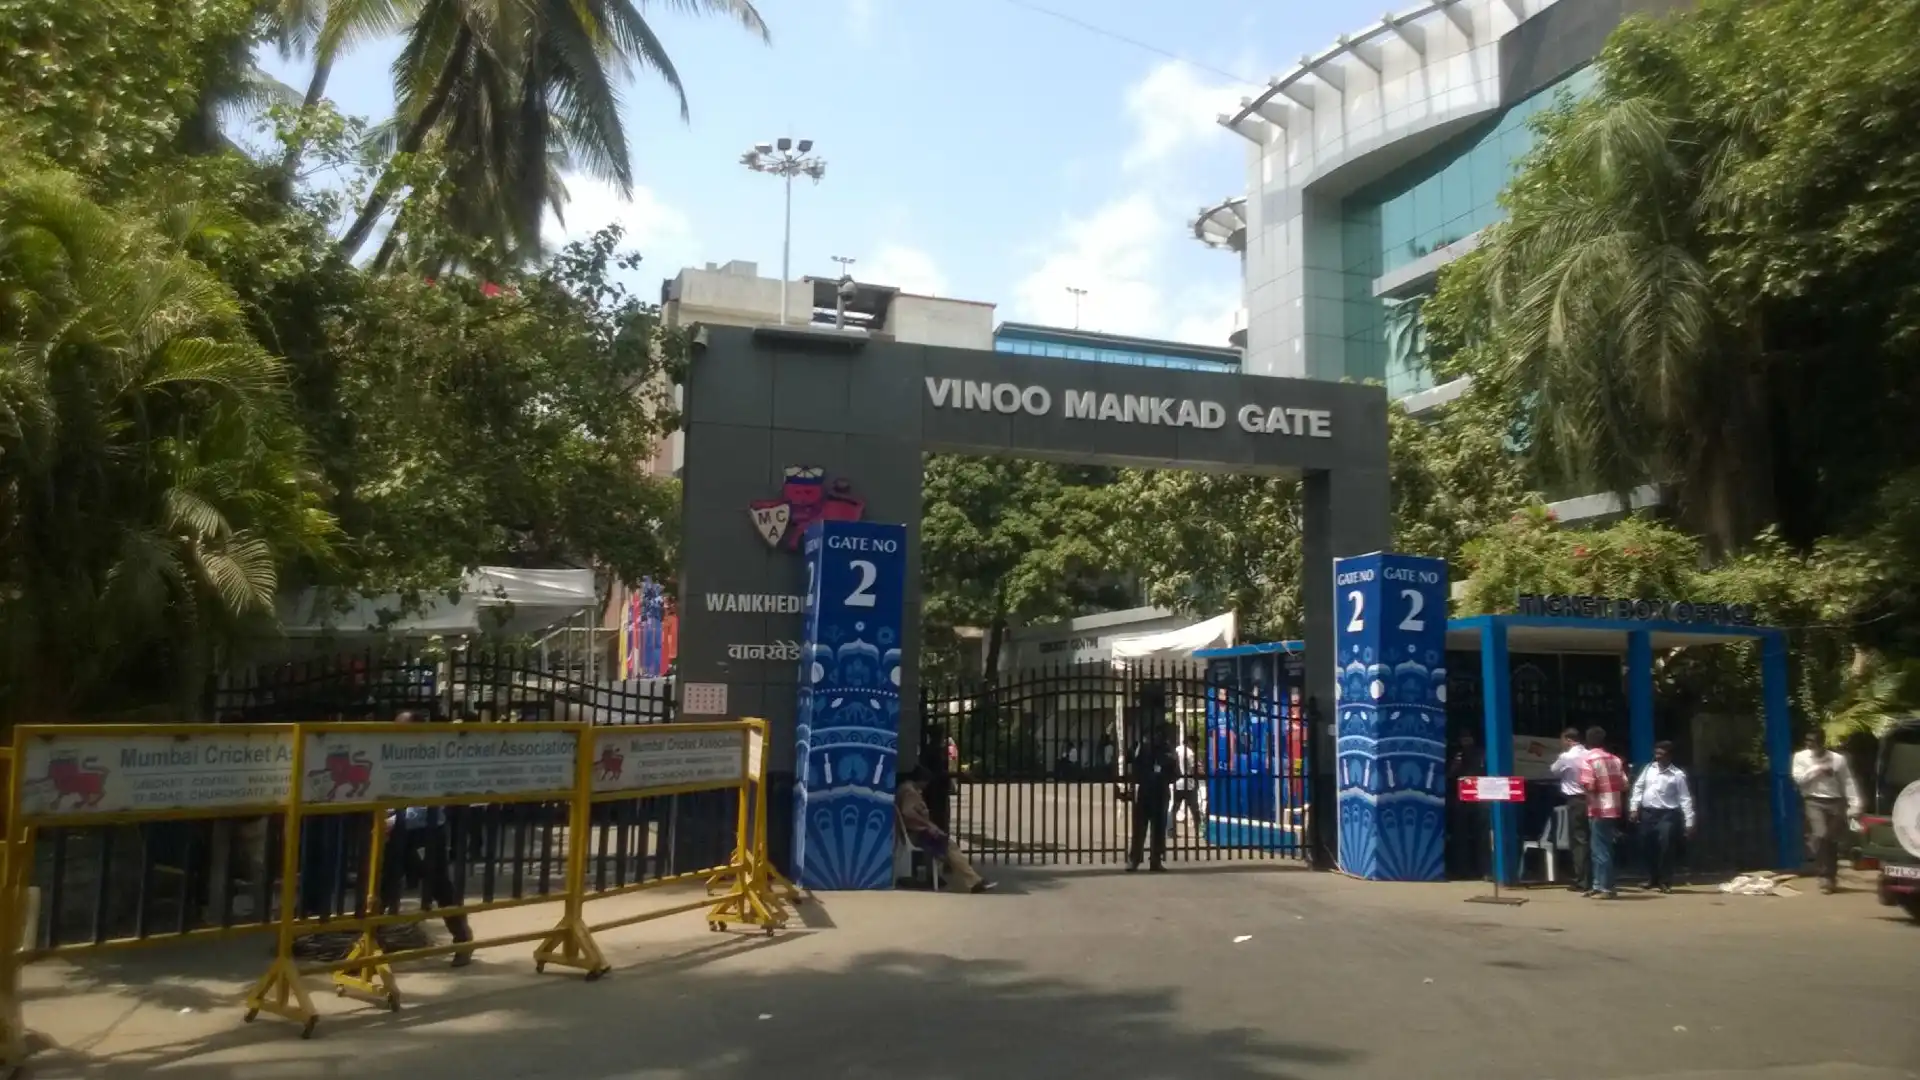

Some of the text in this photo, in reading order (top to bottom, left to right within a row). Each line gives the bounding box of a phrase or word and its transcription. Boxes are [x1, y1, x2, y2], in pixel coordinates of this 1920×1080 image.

[925, 377, 1331, 437] VINOO MANKAD GATE
[828, 536, 868, 550] GATE
[873, 539, 897, 553] NO
[844, 559, 877, 607] 2
[1337, 569, 1375, 586] GATE NO
[1383, 567, 1439, 584] GATE NO
[705, 593, 804, 613] WANKHED
[1347, 590, 1364, 632] 2
[1399, 589, 1425, 631] 2
[1518, 594, 1609, 618] TICKET
[1616, 598, 1665, 621] BOX
[728, 640, 801, 660] वानखेडे
[120, 744, 198, 768] Mumbai
[204, 743, 272, 765] Cricket
[381, 739, 577, 762] Mumbai Cricket Association
